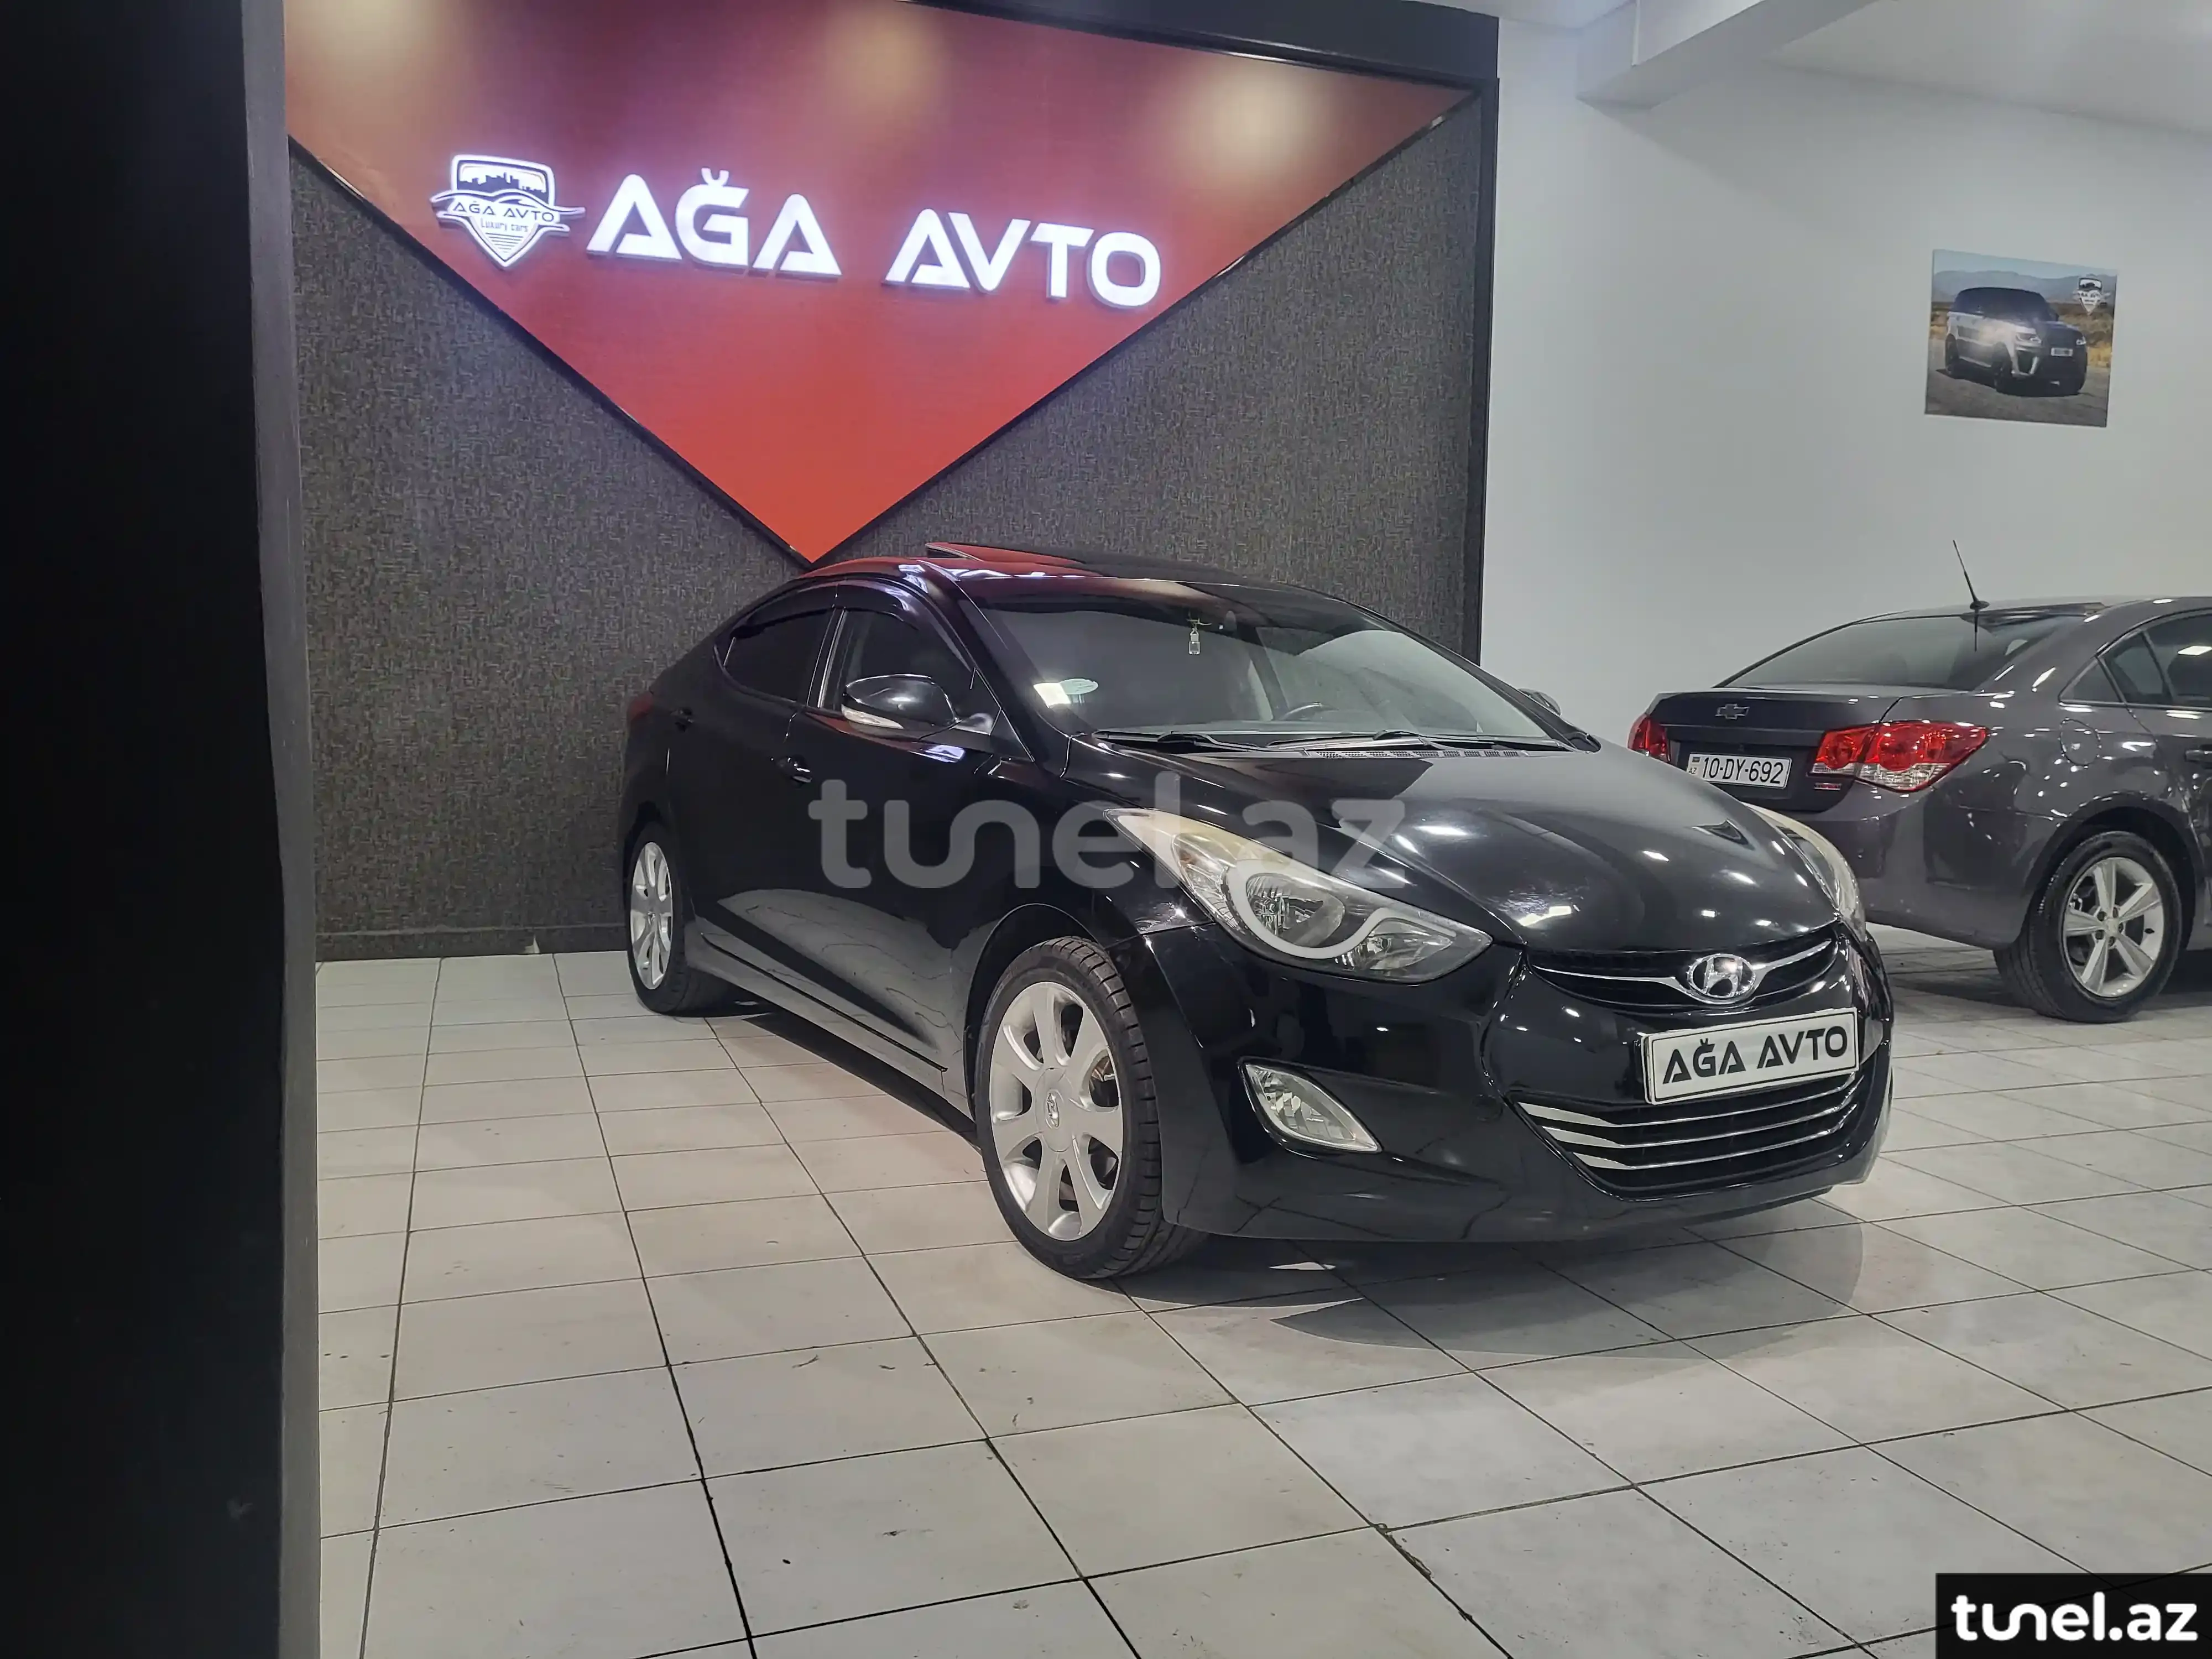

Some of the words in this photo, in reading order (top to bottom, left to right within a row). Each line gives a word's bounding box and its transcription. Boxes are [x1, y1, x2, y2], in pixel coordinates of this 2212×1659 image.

[503, 208, 554, 222] AVTO
[586, 168, 842, 275] AĞA
[885, 208, 1161, 306] AVTO
[1702, 757, 1784, 784] 10-DY-692
[1662, 1037, 1746, 1084] AĞA
[1757, 1026, 1848, 1069] AVTO
